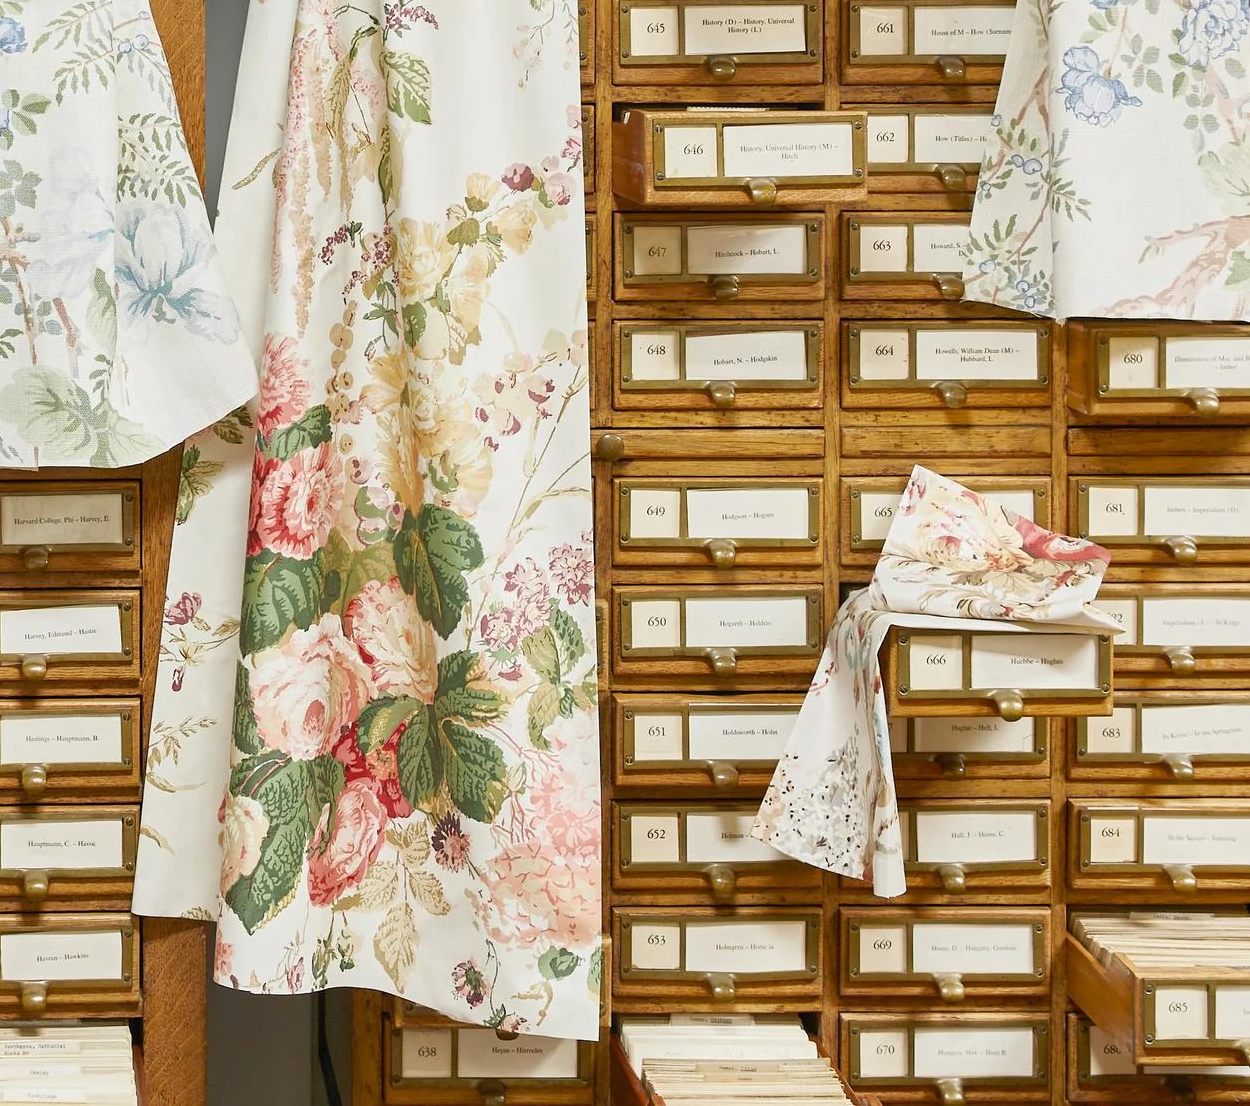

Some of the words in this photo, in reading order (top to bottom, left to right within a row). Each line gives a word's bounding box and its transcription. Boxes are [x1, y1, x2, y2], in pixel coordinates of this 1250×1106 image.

[702, 19, 724, 27] History
[724, 18, 737, 26] (D)
[767, 17, 795, 25] Universal
[646, 22, 666, 34] 645
[727, 26, 750, 35] History
[876, 22, 894, 34] 661
[876, 132, 895, 142] 662
[683, 144, 704, 155] 646
[872, 239, 892, 252] 663
[647, 245, 667, 258] 647
[646, 345, 666, 356] 648
[875, 344, 894, 356] 664
[960, 347, 984, 355] William
[1123, 353, 1143, 365] 680
[646, 505, 666, 517] 649
[874, 506, 893, 518] 665
[1105, 502, 1123, 513] 681
[647, 615, 667, 628] 650
[926, 654, 947, 665] 666
[1040, 657, 1064, 667] Hughes
[648, 726, 665, 737] 651
[1102, 727, 1121, 739] 683
[646, 828, 666, 840] 652
[647, 934, 666, 945] 653
[873, 940, 892, 950] 669
[1168, 1002, 1188, 1013] 685
[417, 1045, 438, 1058] 638
[876, 1044, 895, 1055] 670
